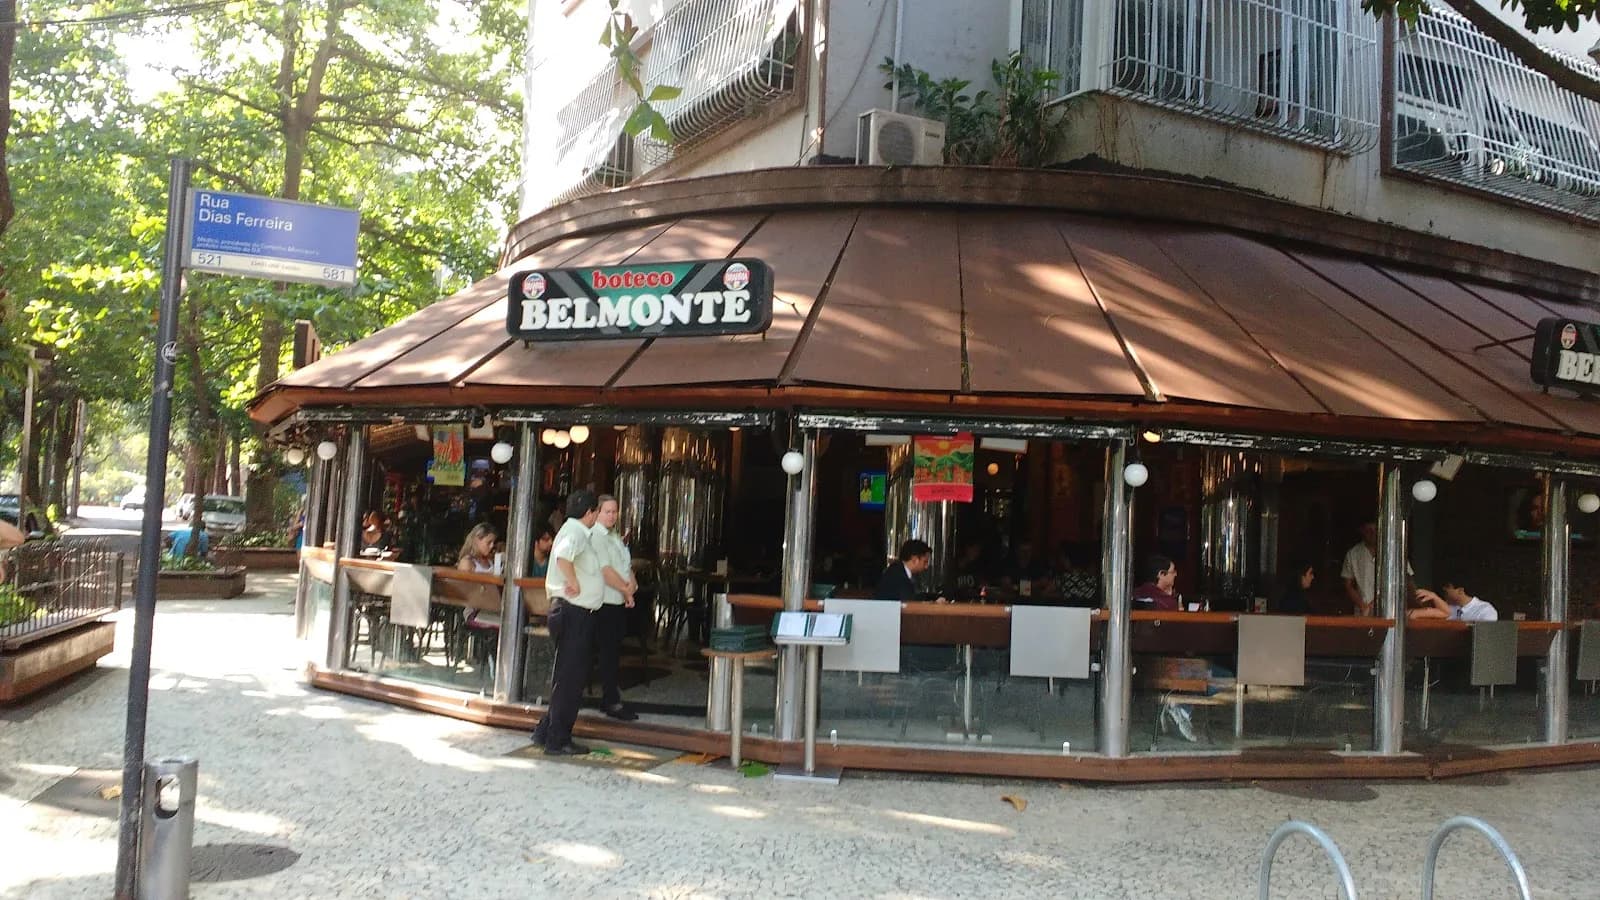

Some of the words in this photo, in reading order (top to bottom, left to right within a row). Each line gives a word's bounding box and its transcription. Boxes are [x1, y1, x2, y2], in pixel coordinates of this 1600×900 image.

[200, 194, 229, 208] Rua
[199, 209, 231, 224] Dias
[236, 212, 293, 231] Ferreira
[197, 253, 222, 267] 521
[322, 267, 346, 281] 581
[592, 270, 674, 289] boteco
[520, 291, 750, 331] BELMONTE
